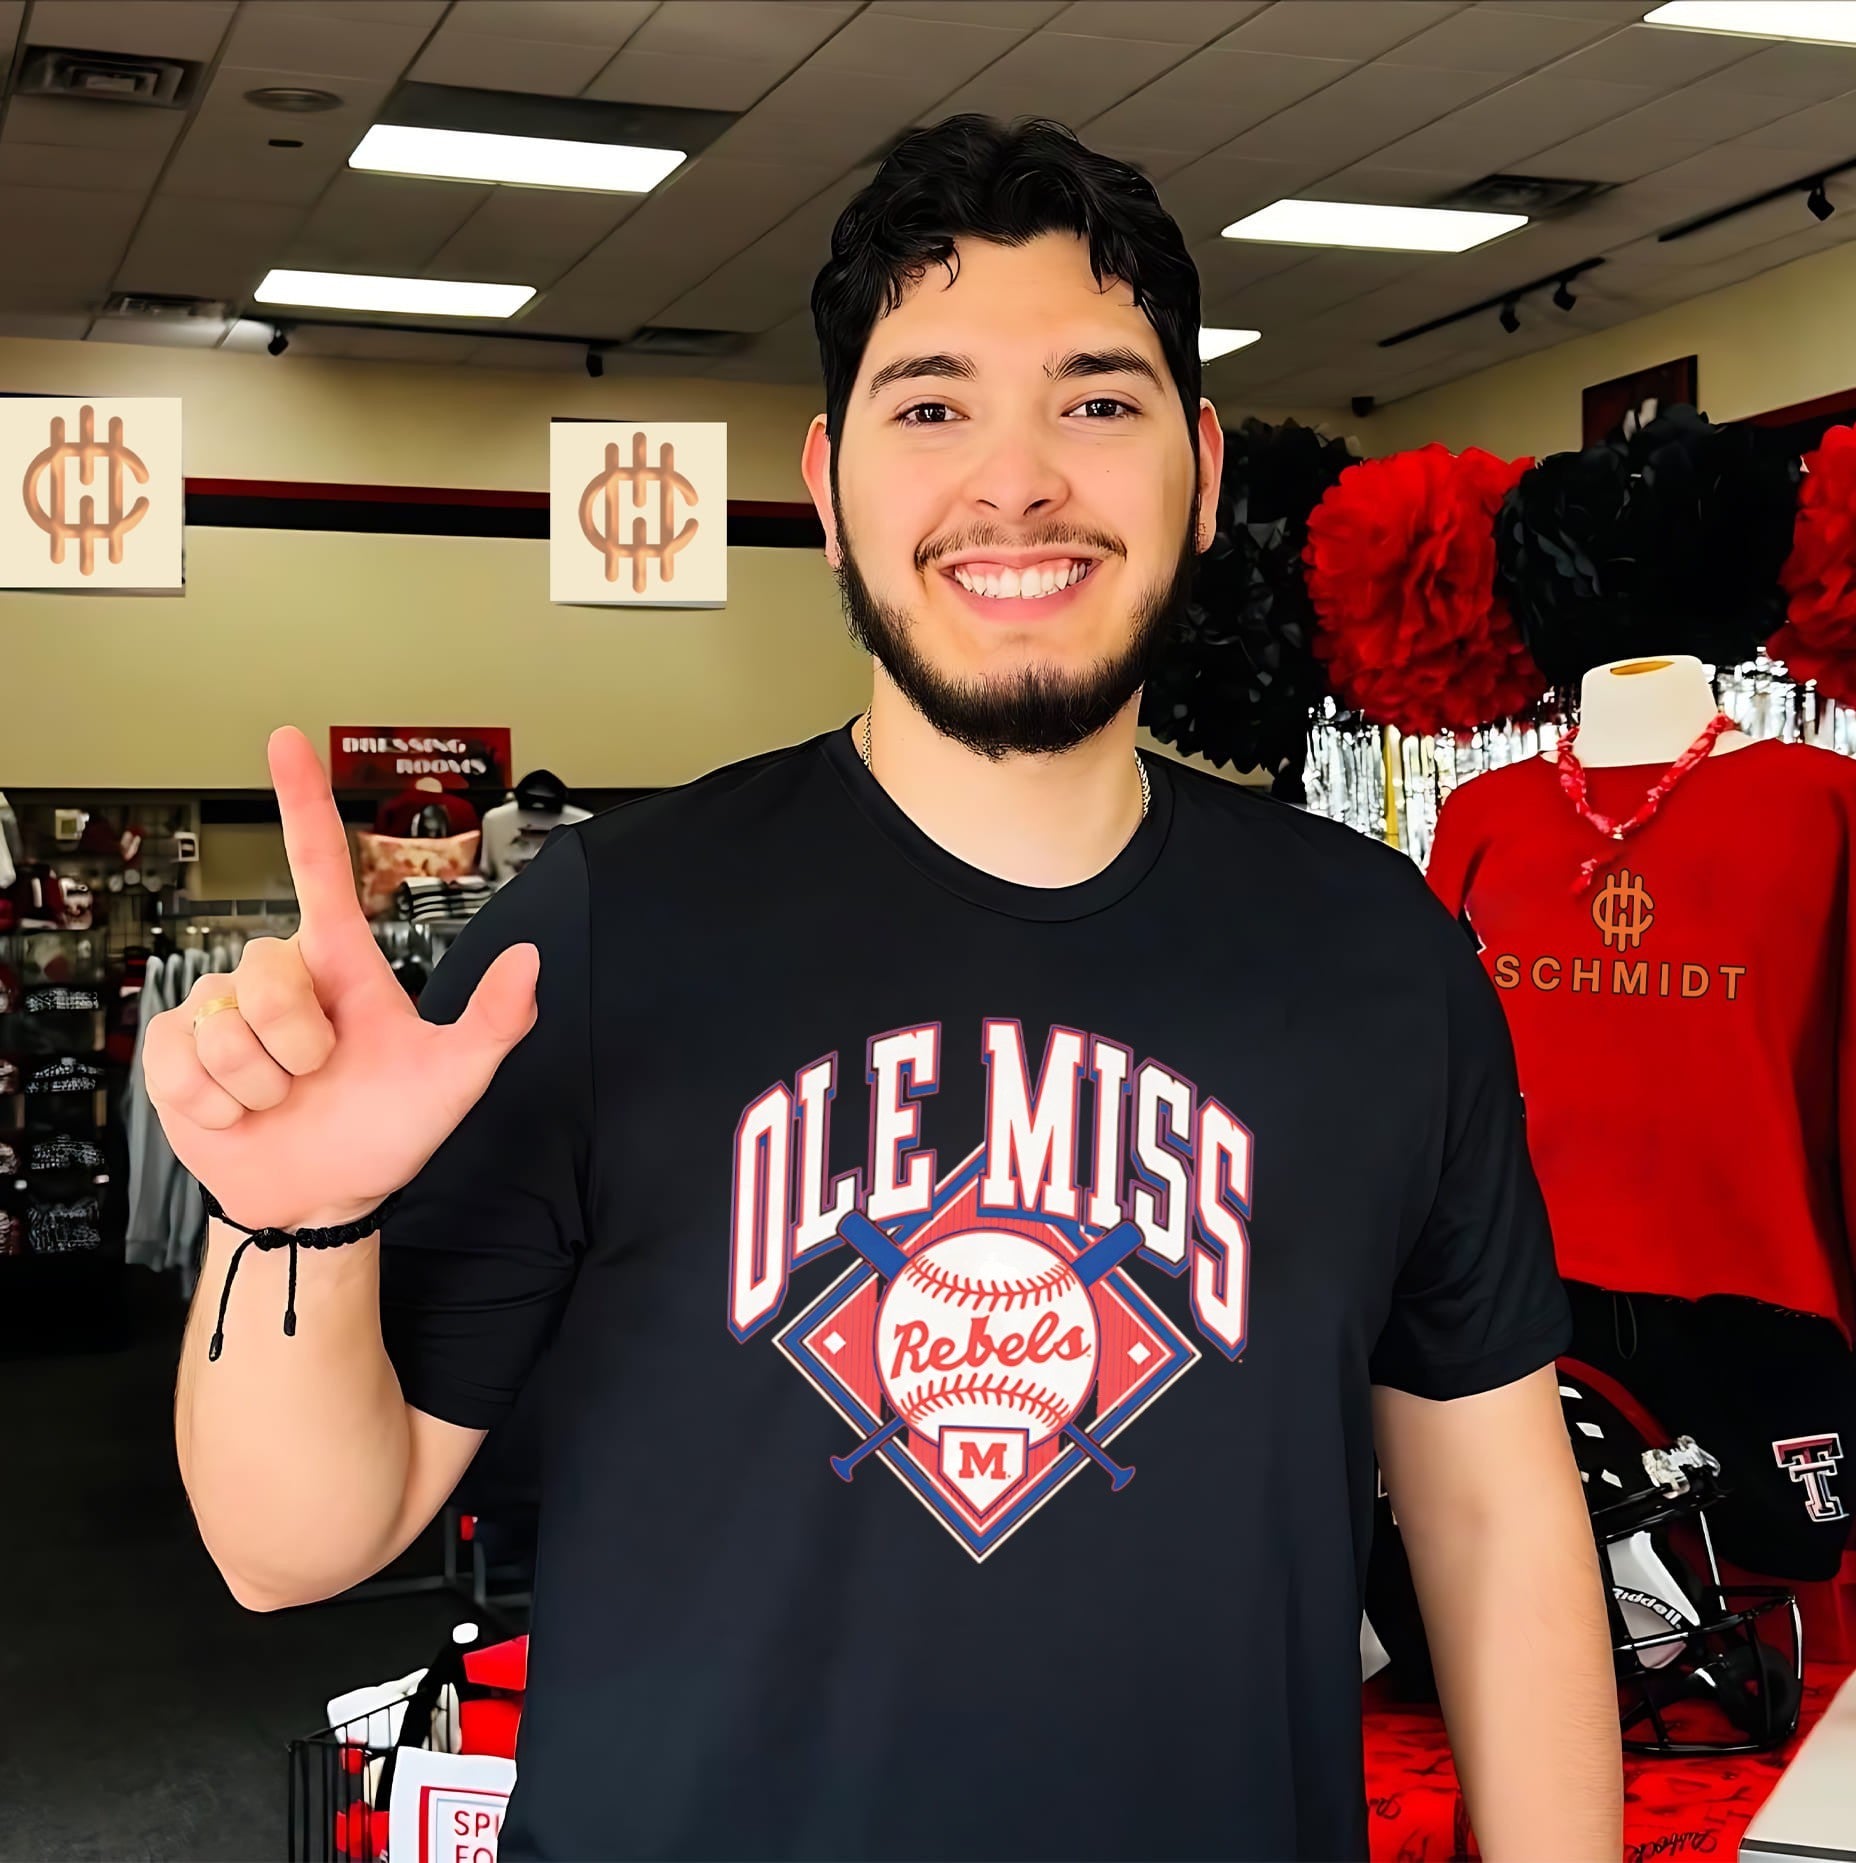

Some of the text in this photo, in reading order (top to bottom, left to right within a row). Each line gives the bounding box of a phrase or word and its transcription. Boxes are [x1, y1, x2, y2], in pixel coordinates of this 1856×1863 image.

[342, 737, 467, 754] DRESSING
[396, 758, 487, 775] ROOMS
[1494, 954, 1747, 1000] SCHMIDT
[727, 1017, 1254, 1362] OLE MISS
[890, 1311, 1092, 1380] Rebels
[958, 1441, 1008, 1480] M
